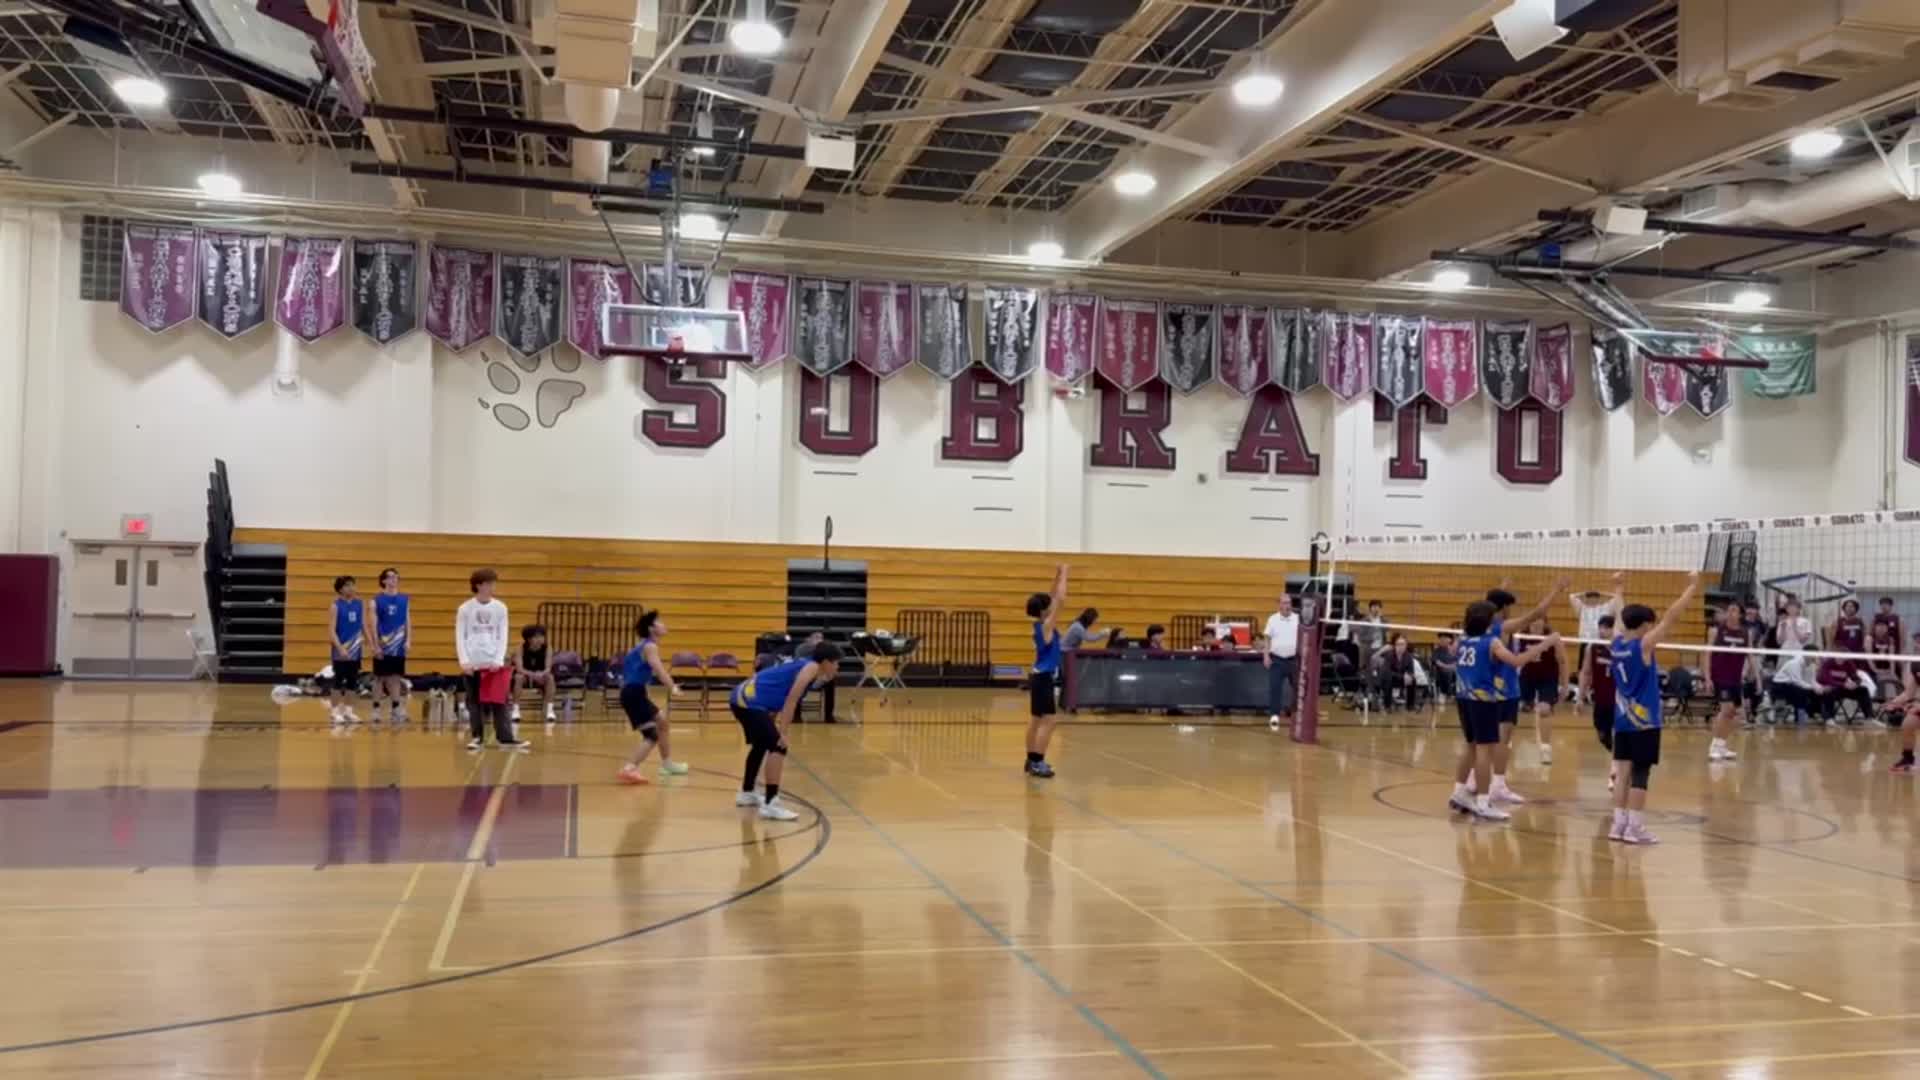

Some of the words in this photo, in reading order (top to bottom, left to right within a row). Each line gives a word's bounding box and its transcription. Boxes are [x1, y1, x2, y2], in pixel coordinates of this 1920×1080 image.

[641, 356, 1566, 485] SOBRATO
[1458, 646, 1477, 667] 23
[1616, 660, 1629, 684] 1
